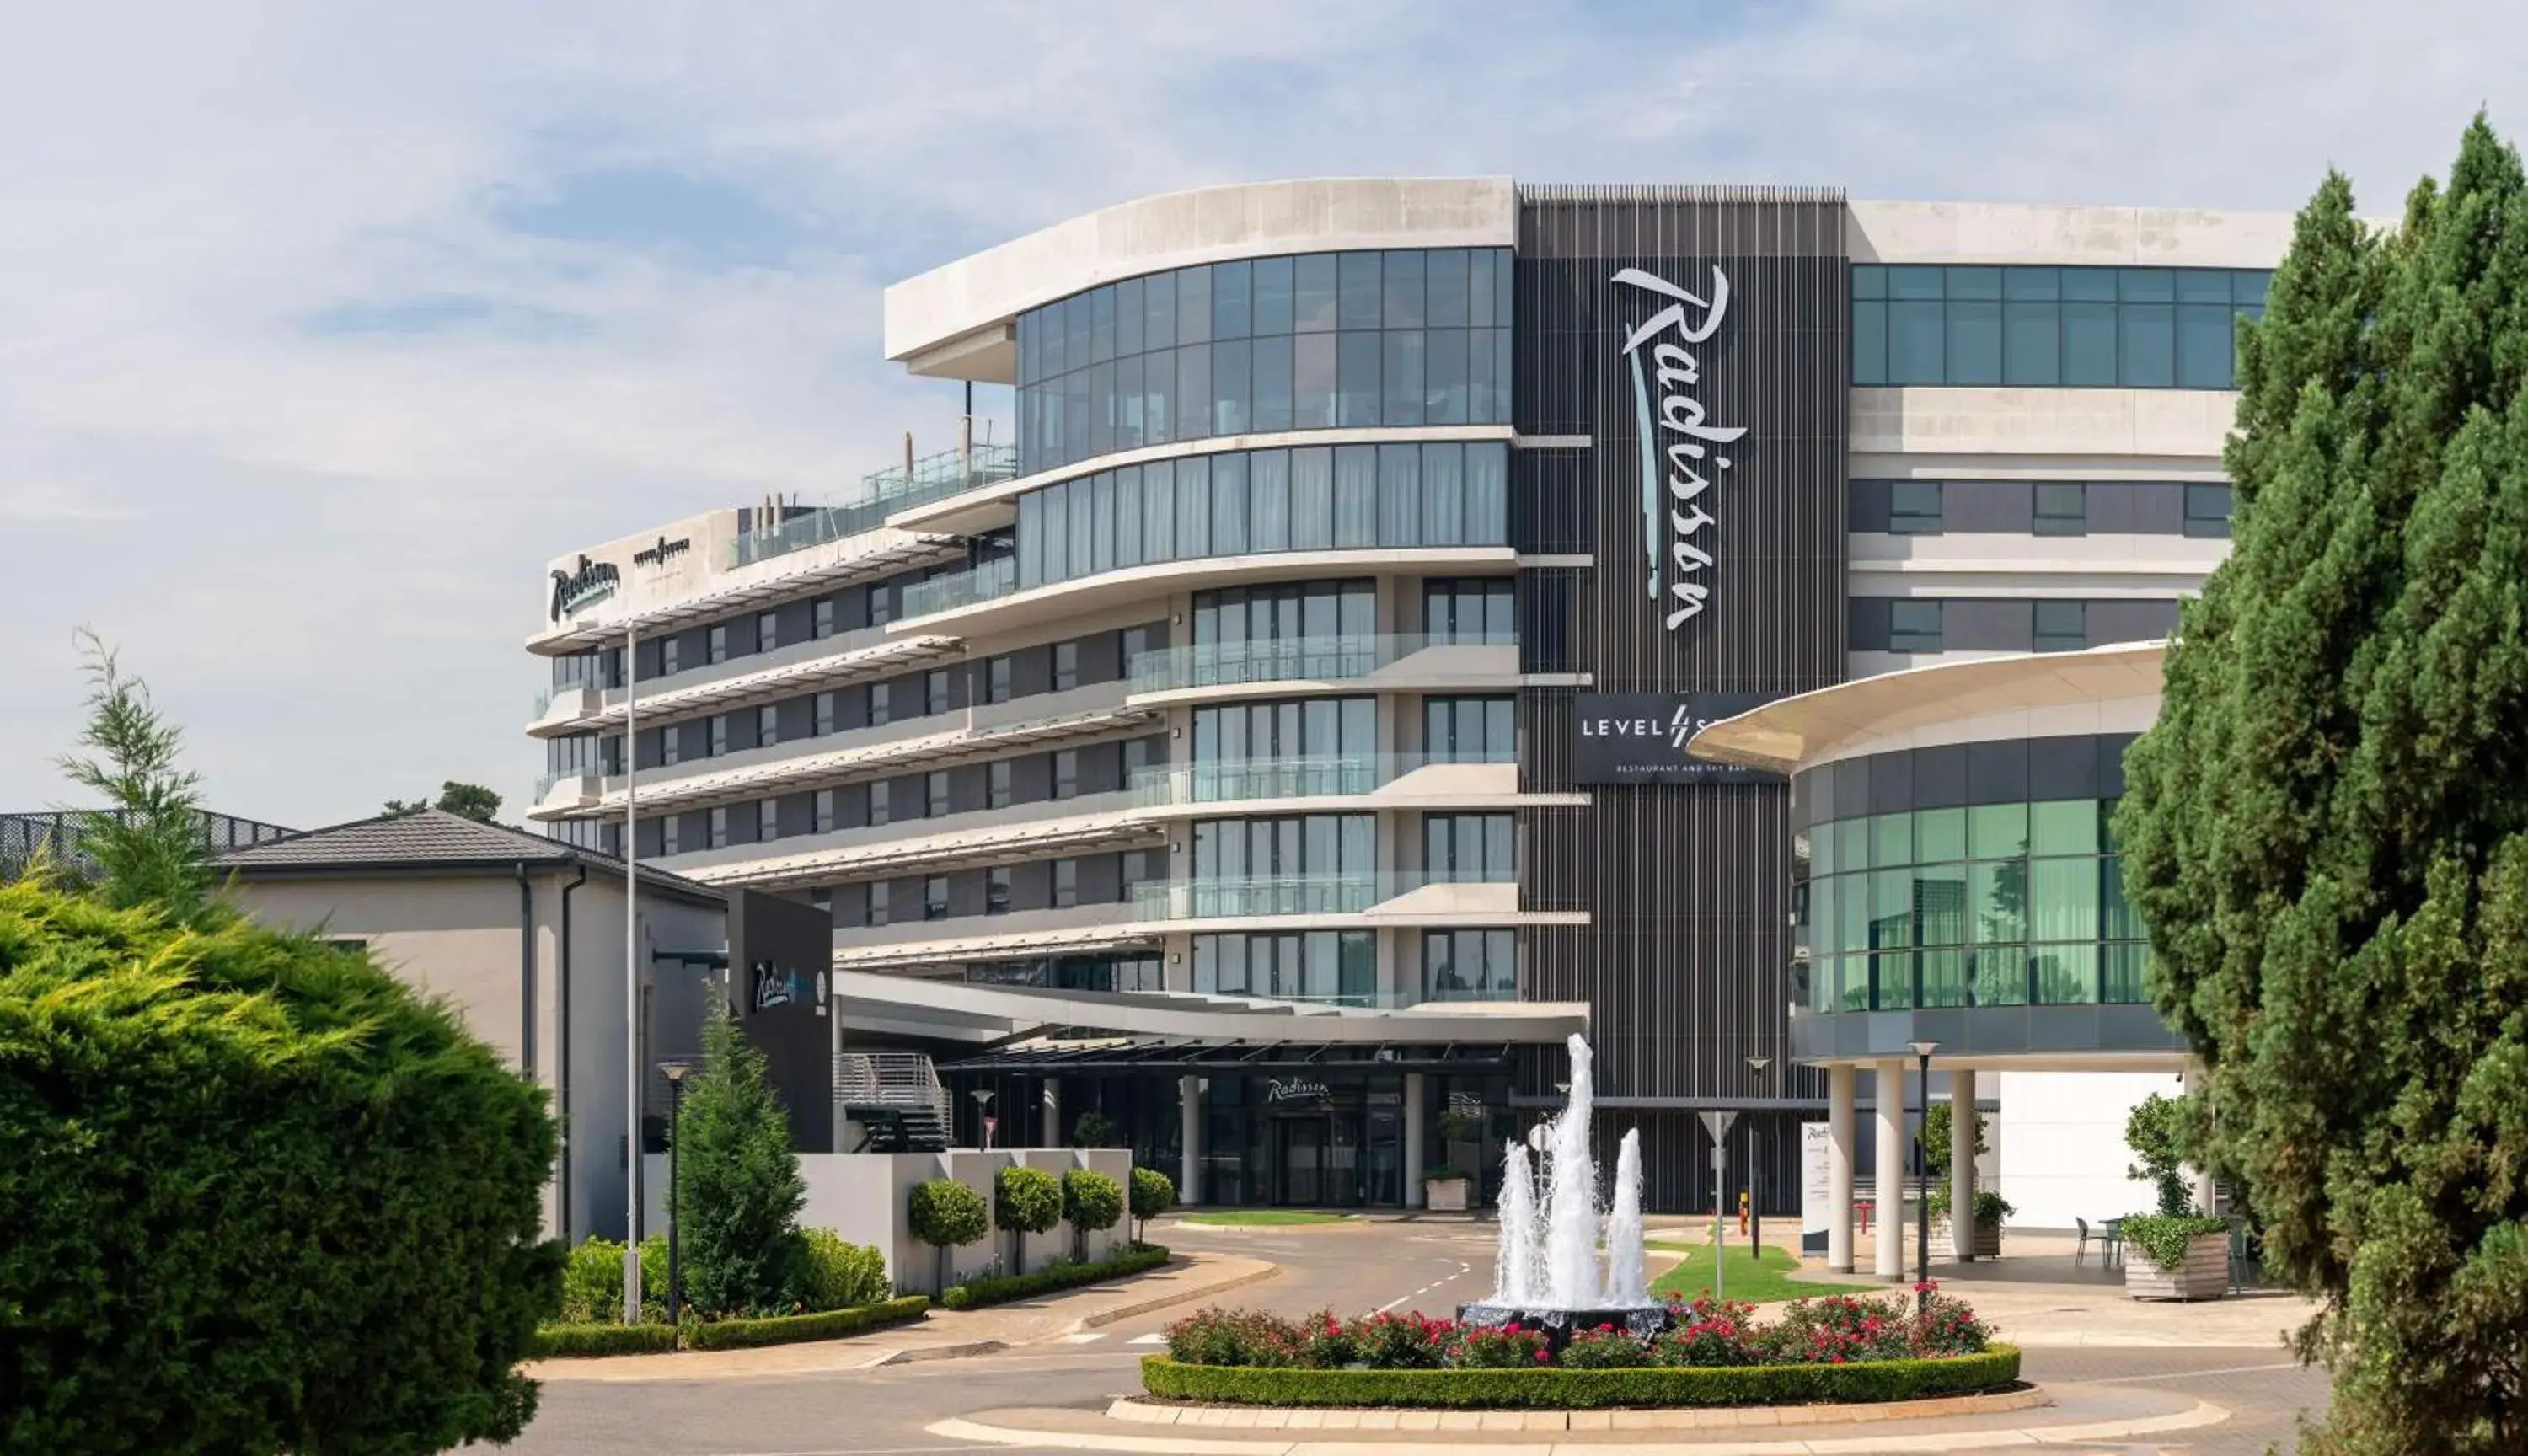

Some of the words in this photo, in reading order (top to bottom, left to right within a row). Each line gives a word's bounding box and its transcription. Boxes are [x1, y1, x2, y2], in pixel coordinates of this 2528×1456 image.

[1611, 264, 1748, 630] Radisson
[1582, 719, 1663, 736] LEVEL
[1616, 764, 1678, 773] RESTAURANT
[1682, 764, 1703, 773] AND
[1268, 1076, 1329, 1102] Radisson
